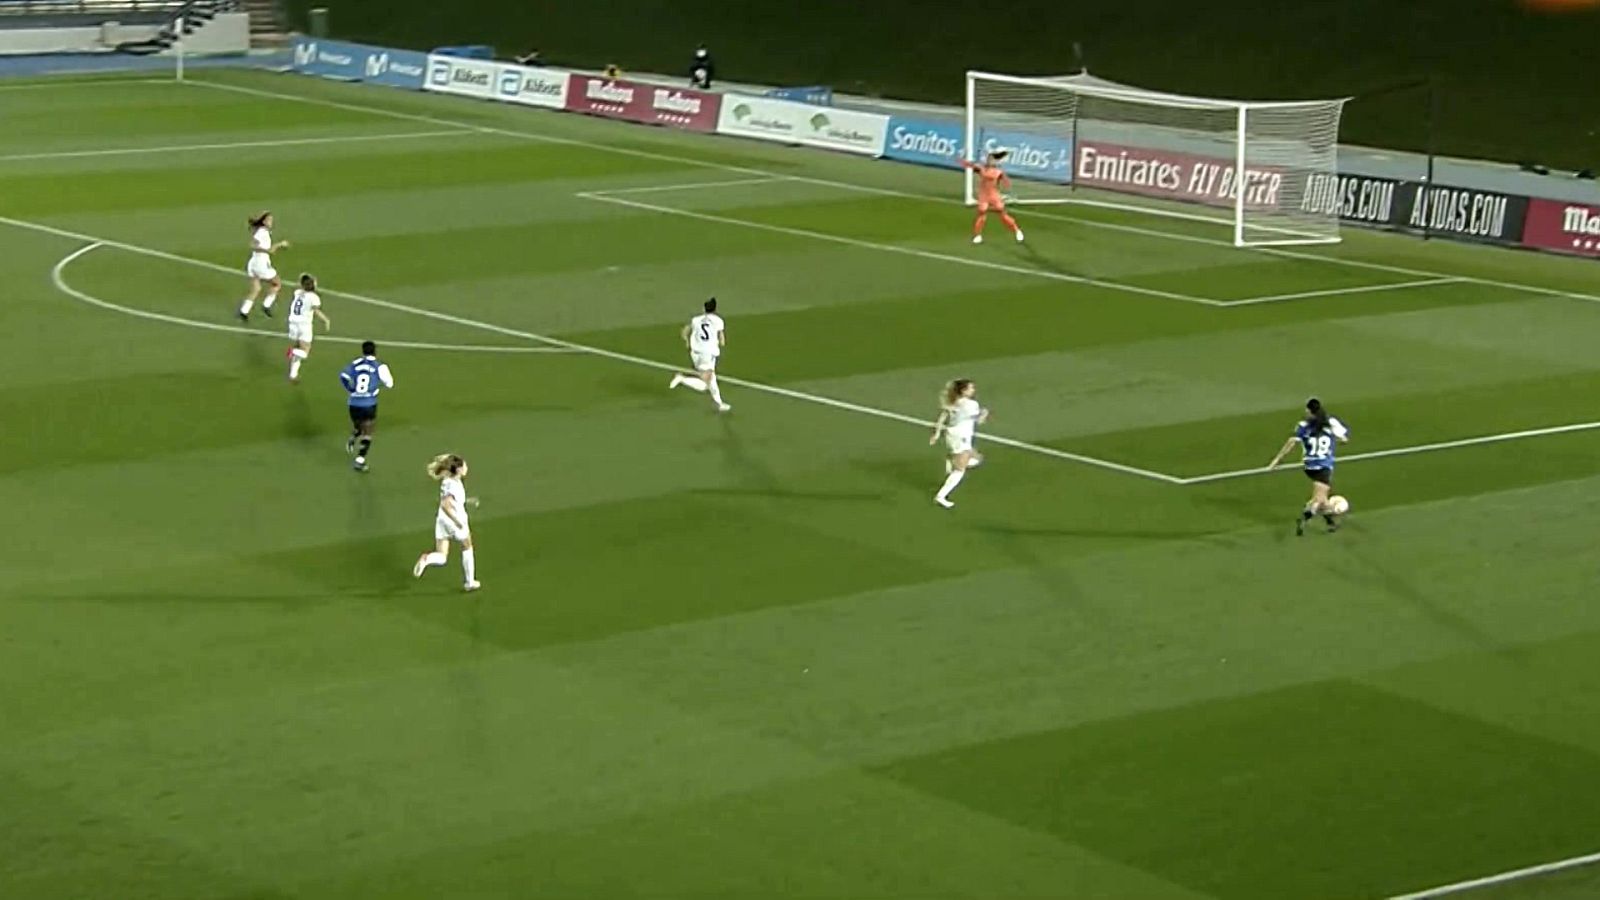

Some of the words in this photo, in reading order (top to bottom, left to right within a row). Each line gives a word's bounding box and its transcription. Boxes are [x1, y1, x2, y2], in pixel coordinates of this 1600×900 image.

[890, 126, 958, 157] Sanitas
[981, 138, 1052, 168] Snitas
[1078, 147, 1181, 191] Emirates
[1187, 162, 1220, 195] FLY
[1300, 173, 1394, 222] ADIDAS.COM
[293, 298, 304, 316] 8
[355, 373, 370, 394] 8
